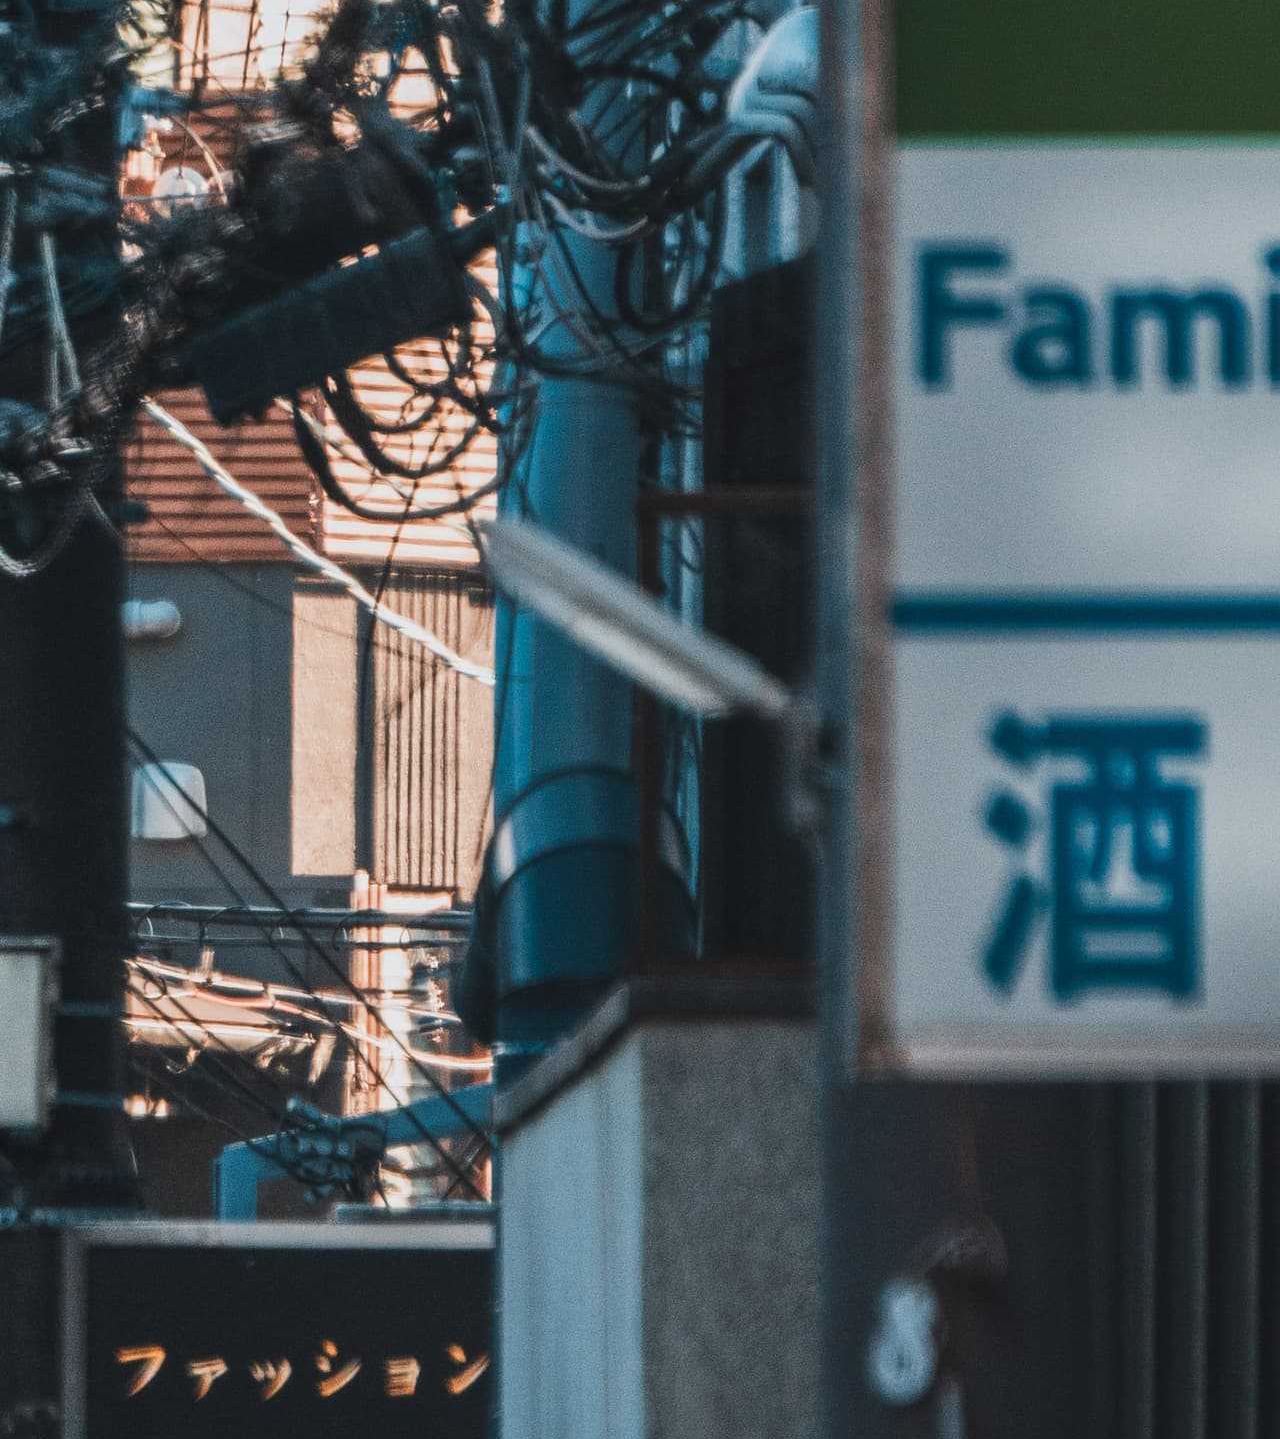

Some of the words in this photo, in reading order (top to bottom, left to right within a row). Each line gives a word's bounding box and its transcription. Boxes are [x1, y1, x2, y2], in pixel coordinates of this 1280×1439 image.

[977, 702, 1209, 1006] 酒
[114, 1338, 491, 1400] ファッション
